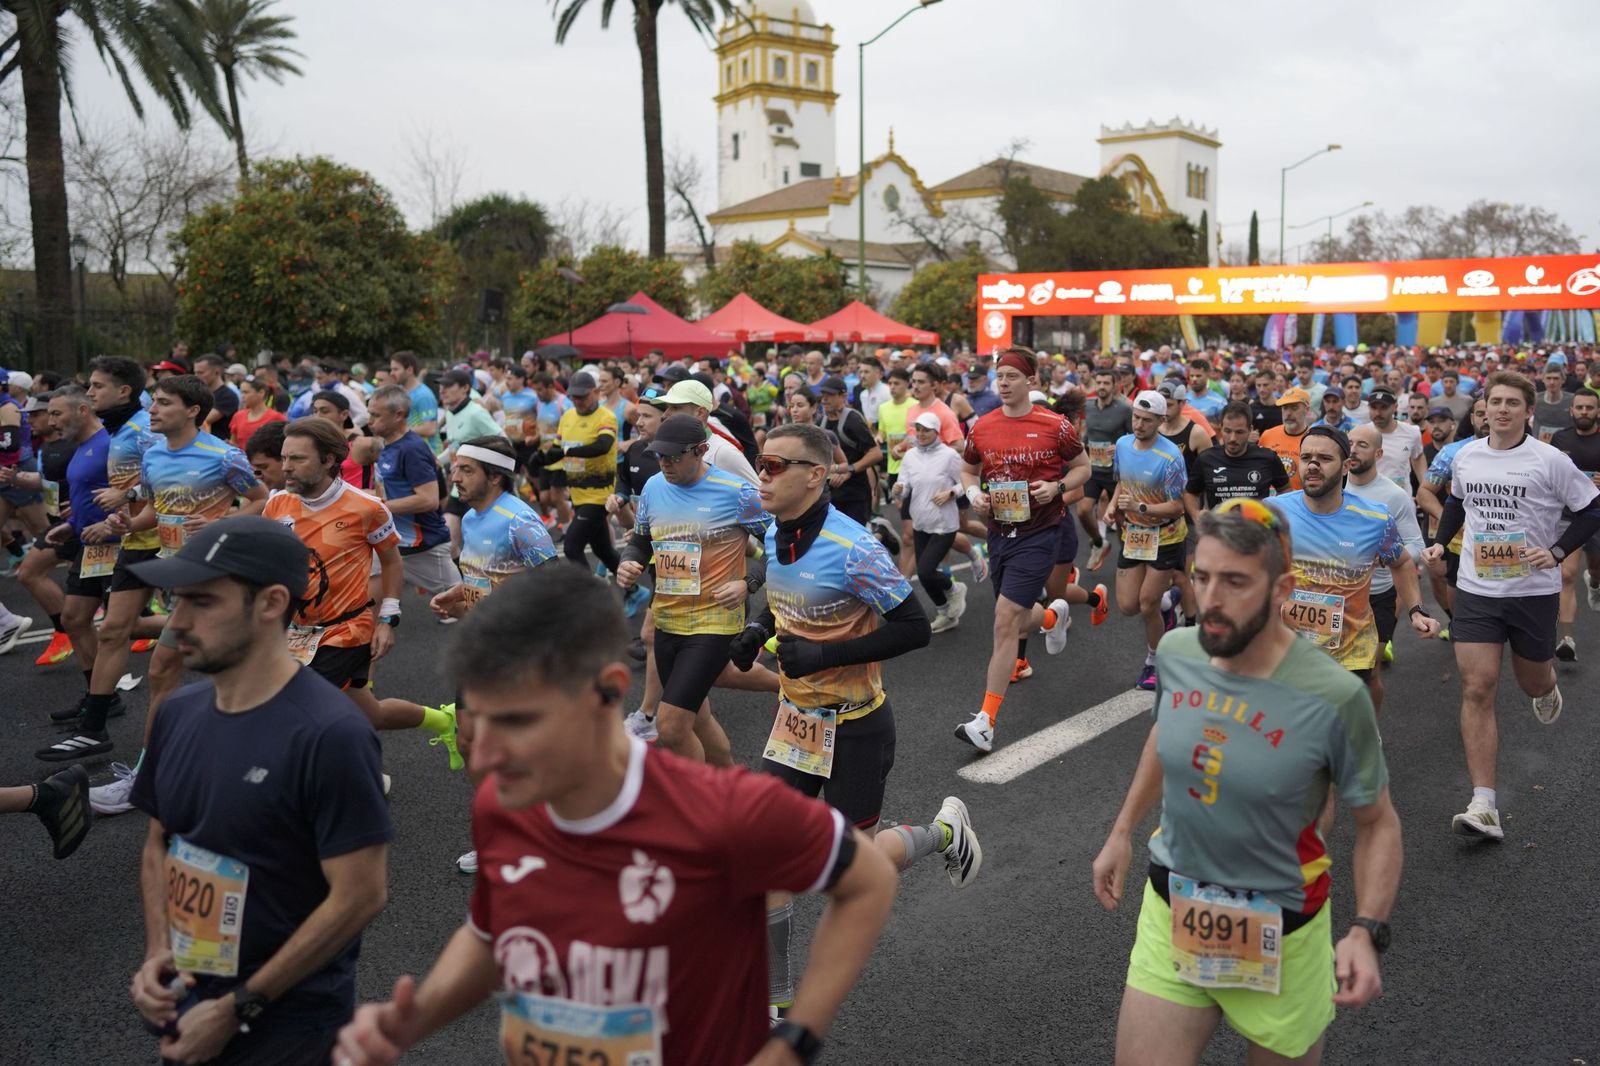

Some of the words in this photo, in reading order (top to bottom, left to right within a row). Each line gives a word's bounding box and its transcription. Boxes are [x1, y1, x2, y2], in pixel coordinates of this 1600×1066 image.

[994, 492, 1019, 504] 5914
[1466, 482, 1527, 498] DONOSTI
[1472, 498, 1520, 510] SEVILLA
[1131, 533, 1150, 544] 5547
[86, 547, 110, 559] 6387
[1481, 545, 1514, 559] 5444
[659, 554, 686, 570] 7044
[1289, 604, 1327, 625] 4705
[785, 712, 817, 743] 4231
[1171, 690, 1285, 749] POLILLA
[1182, 906, 1249, 944] 4991
